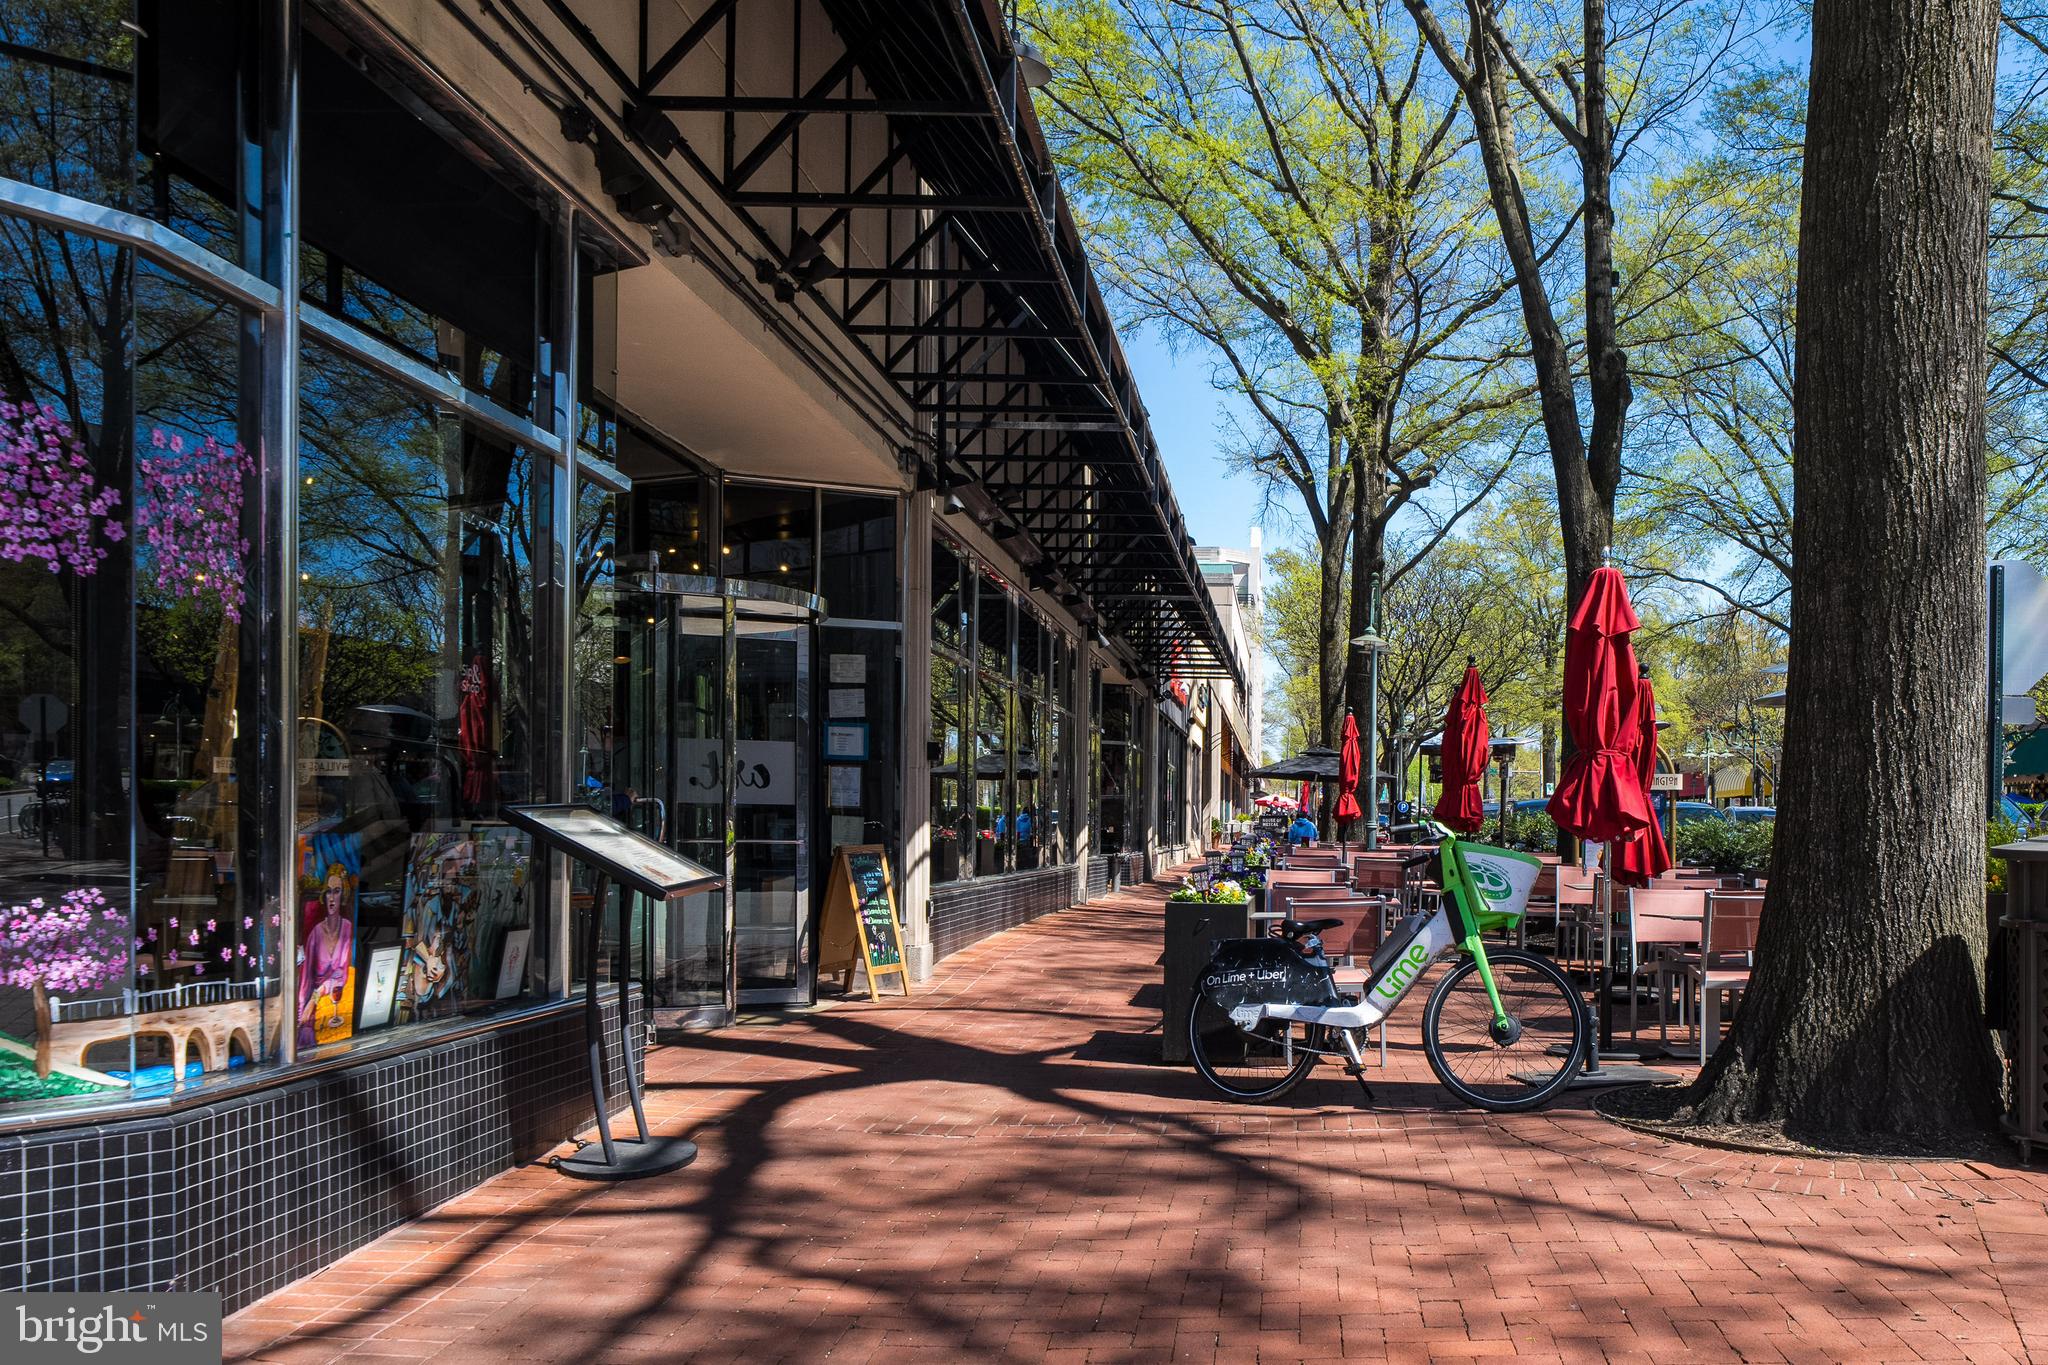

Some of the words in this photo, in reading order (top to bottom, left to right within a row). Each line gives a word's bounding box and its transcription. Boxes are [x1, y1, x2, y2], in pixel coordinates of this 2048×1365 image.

[1653, 776, 1678, 786] INGTON
[1206, 975, 1221, 986] On
[1222, 973, 1247, 984] Lime
[1257, 969, 1284, 980] Uber
